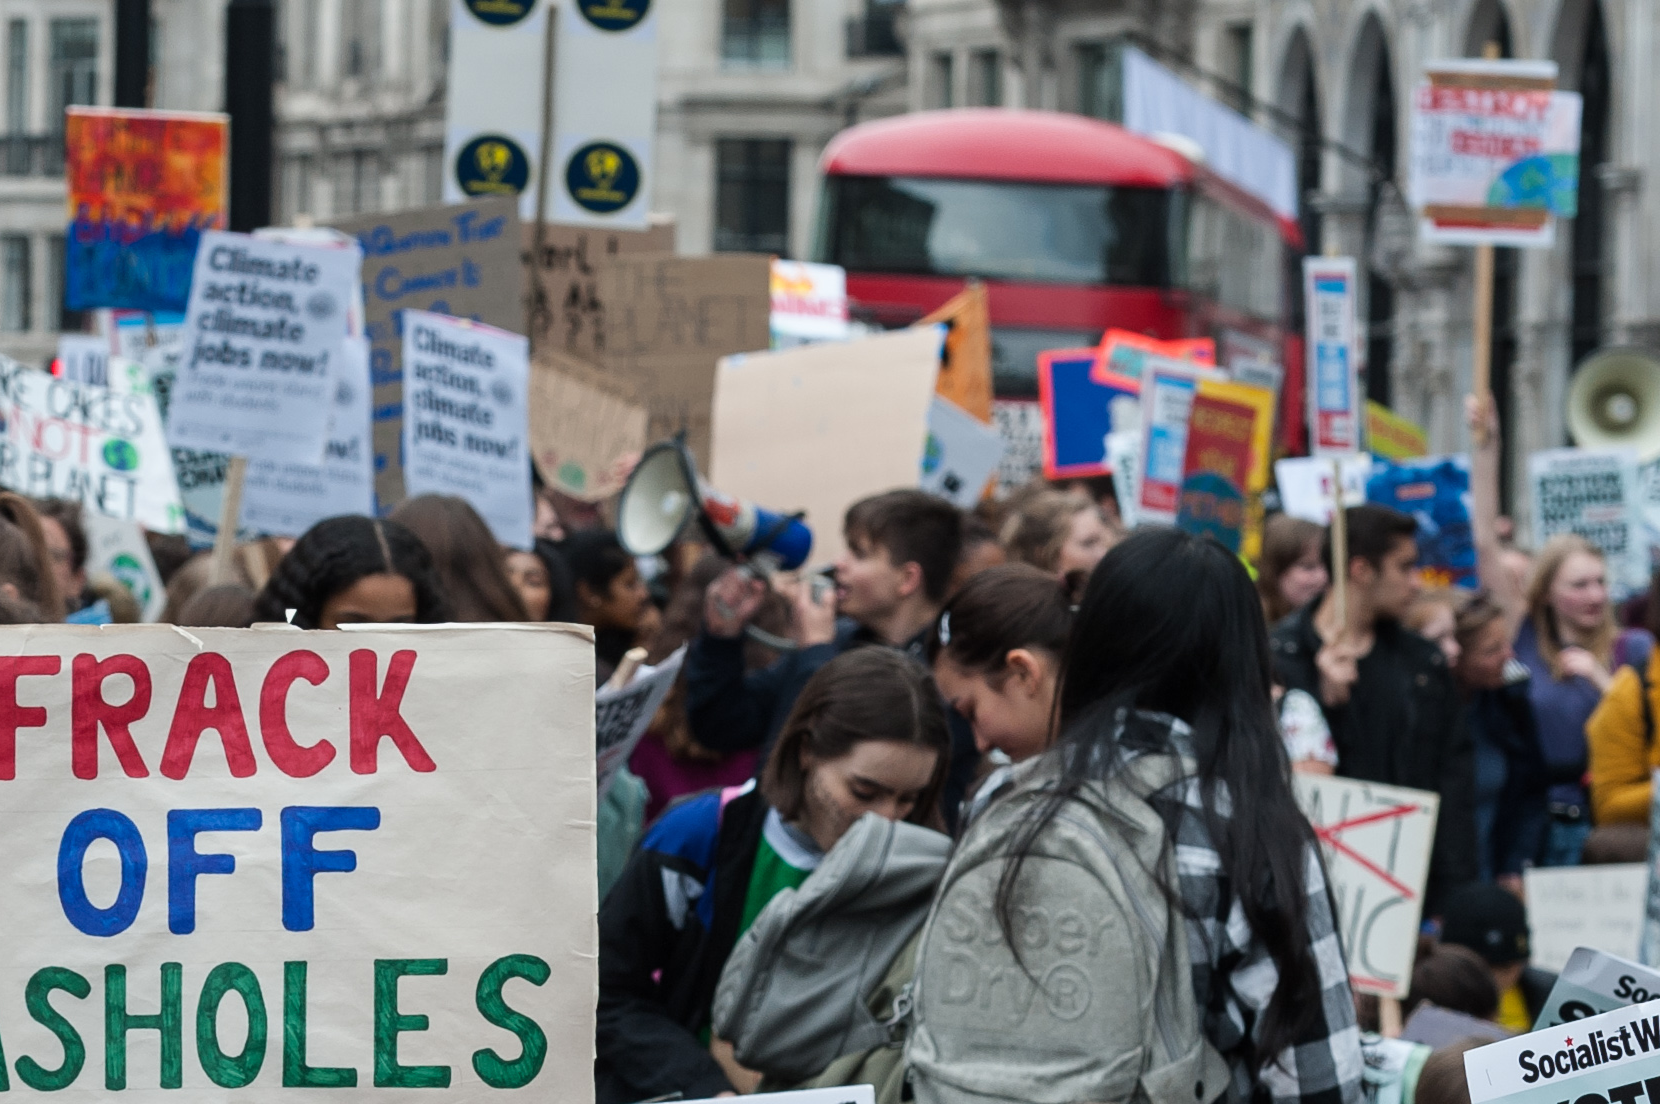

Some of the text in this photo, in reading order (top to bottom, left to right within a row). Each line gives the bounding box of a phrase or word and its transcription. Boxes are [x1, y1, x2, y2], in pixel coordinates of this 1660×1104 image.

[208, 245, 320, 283] Climate
[196, 306, 305, 342] climate
[189, 338, 253, 369] jobs
[413, 326, 496, 368] Climate
[9, 405, 106, 464] NOT
[56, 805, 381, 938] OFF
